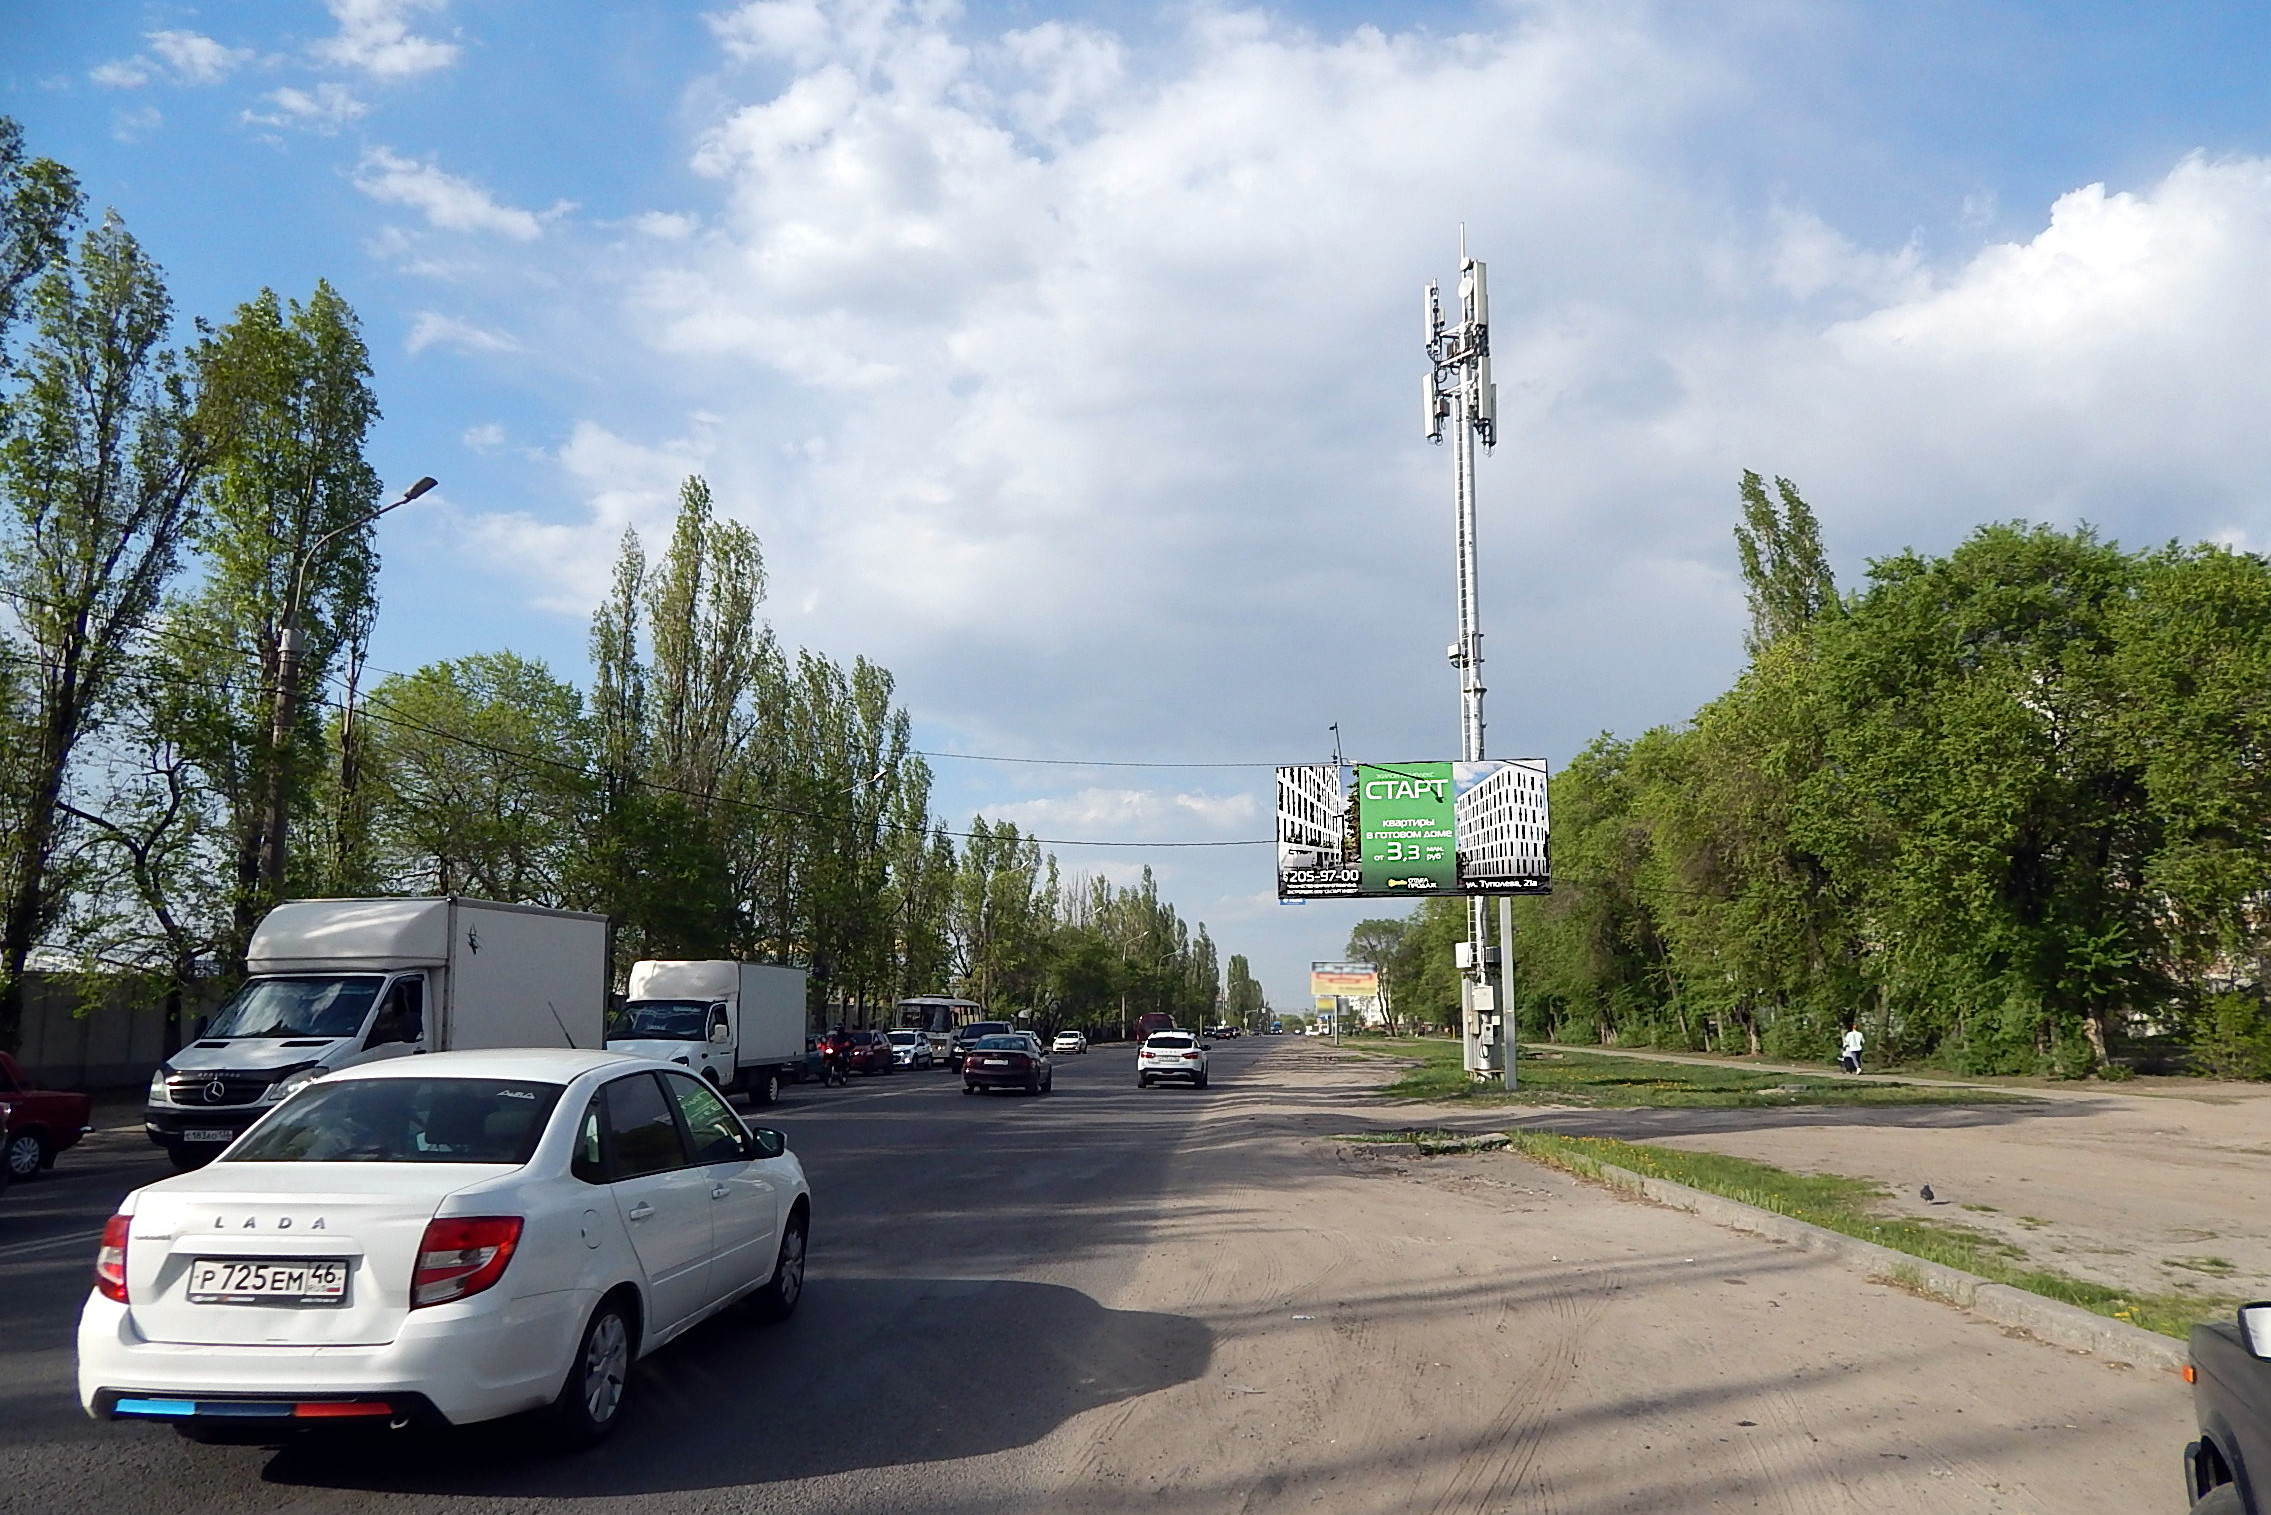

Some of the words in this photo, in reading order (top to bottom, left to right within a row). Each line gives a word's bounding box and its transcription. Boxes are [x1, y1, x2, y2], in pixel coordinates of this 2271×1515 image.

[1365, 779, 1449, 800] СТАРТ
[1382, 818, 1435, 828] квартиры
[1387, 841, 1420, 862] 3,3
[1289, 869, 1359, 882] 205-97-00
[214, 1216, 326, 1229] LADA
